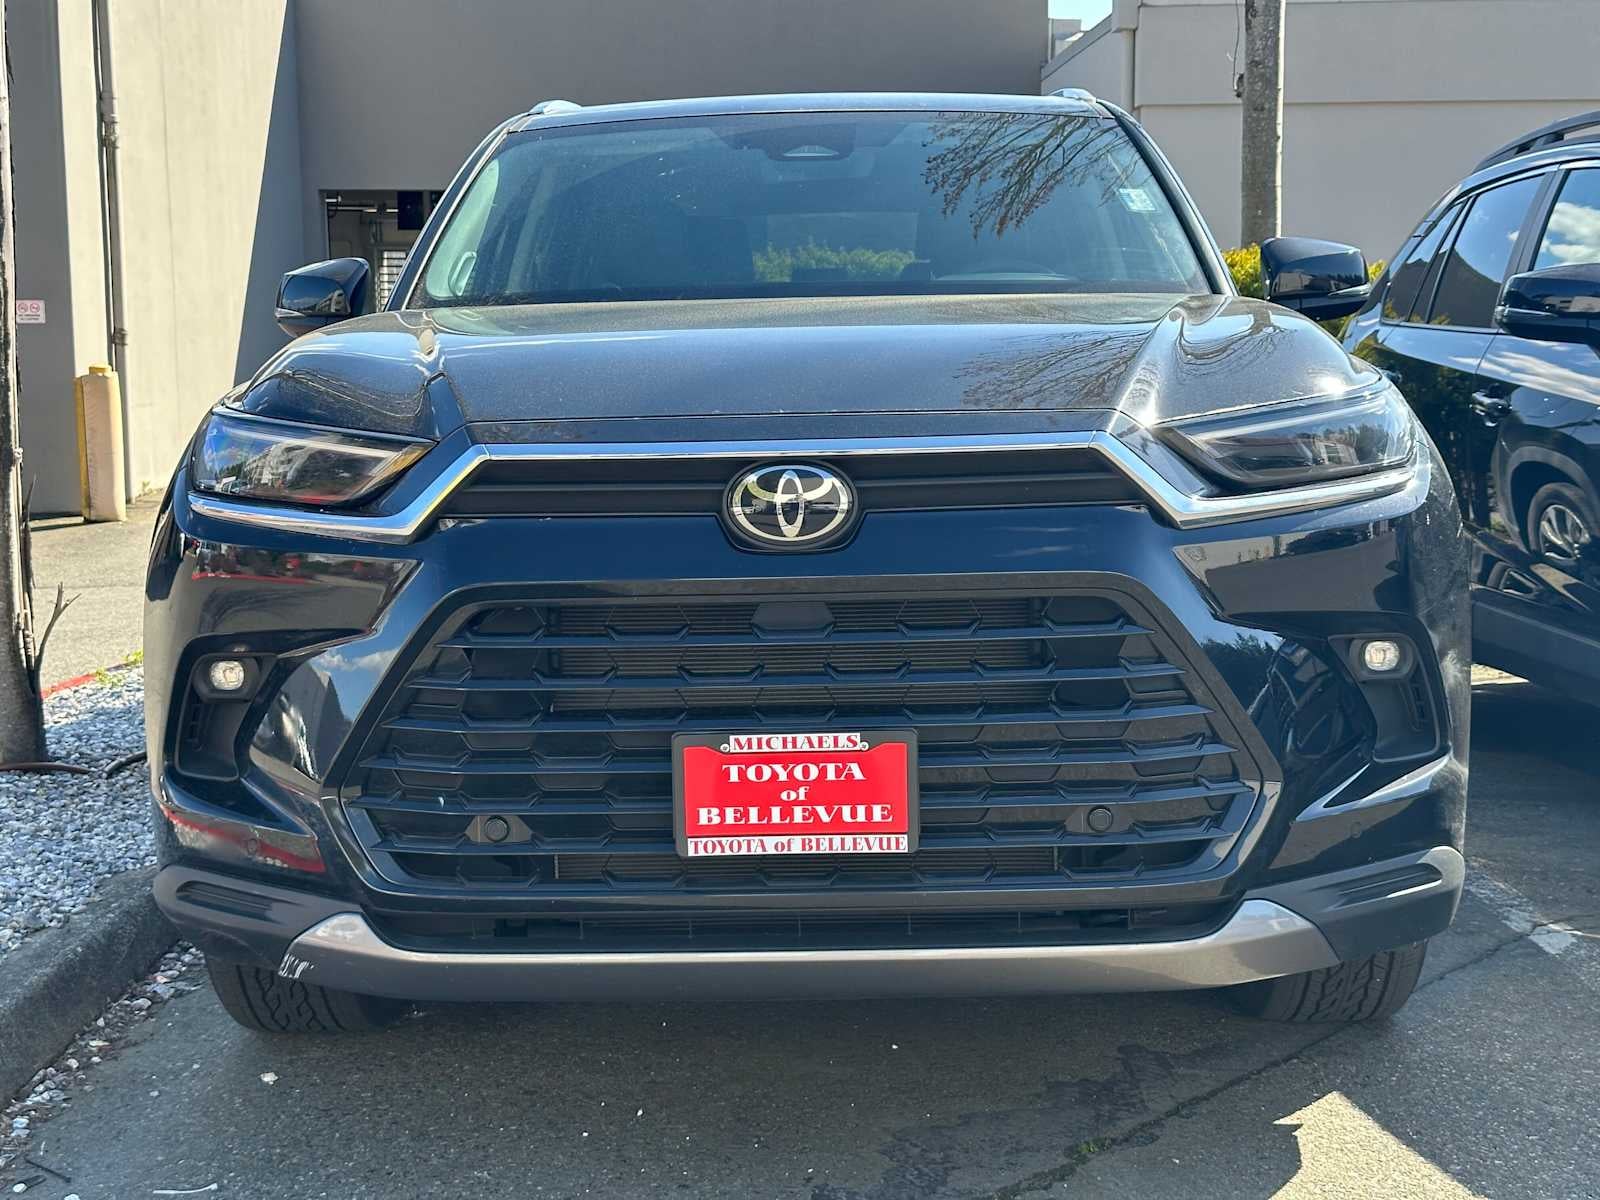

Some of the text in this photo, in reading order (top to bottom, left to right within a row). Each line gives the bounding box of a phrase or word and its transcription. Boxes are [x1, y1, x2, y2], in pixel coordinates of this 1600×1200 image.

[733, 735, 858, 751] MICHAELS
[722, 762, 866, 782] TOYOTA
[780, 786, 809, 801] of
[697, 804, 893, 825] BELLEVUE
[690, 837, 906, 854] TOYOTA of BELLEVUE
